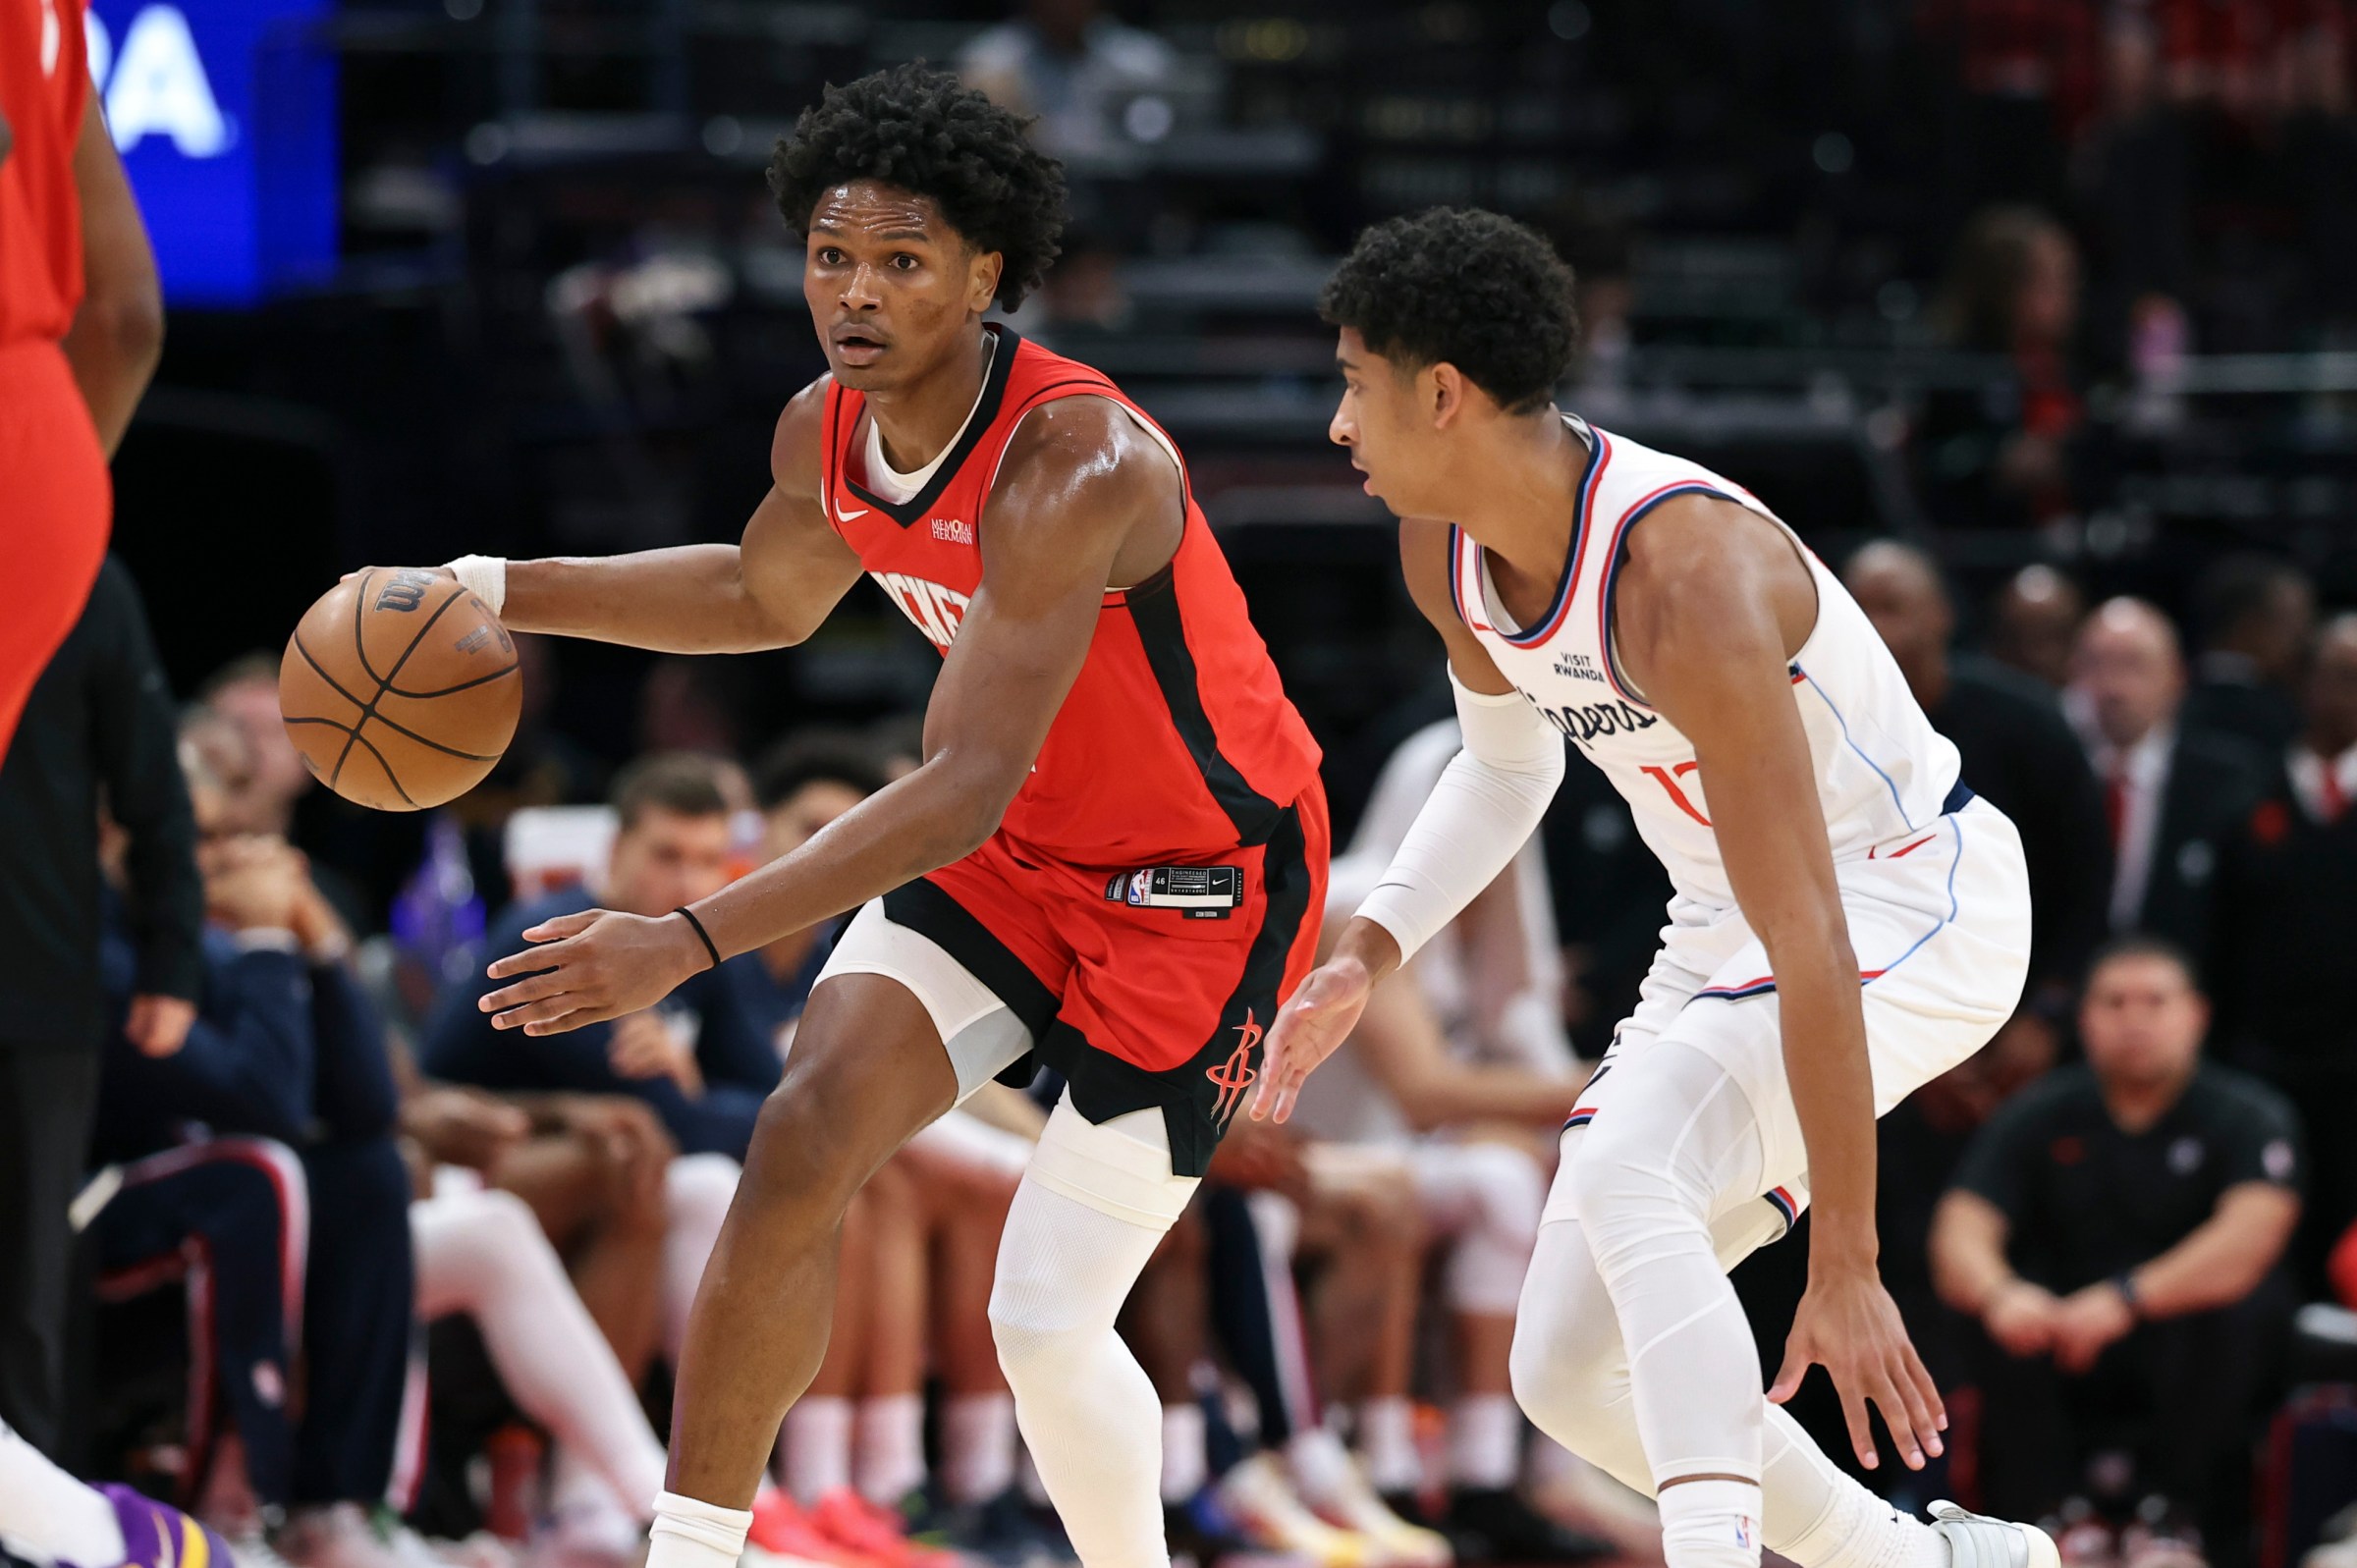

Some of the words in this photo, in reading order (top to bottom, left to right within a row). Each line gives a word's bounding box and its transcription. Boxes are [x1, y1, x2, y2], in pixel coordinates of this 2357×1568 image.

[932, 527, 972, 545] HERMANN
[1561, 652, 1591, 668] VISIT
[1554, 664, 1605, 682] RWANDA
[1516, 686, 1658, 751] ippers
[1639, 761, 1712, 827] 1
[1155, 877, 1166, 886] 46
